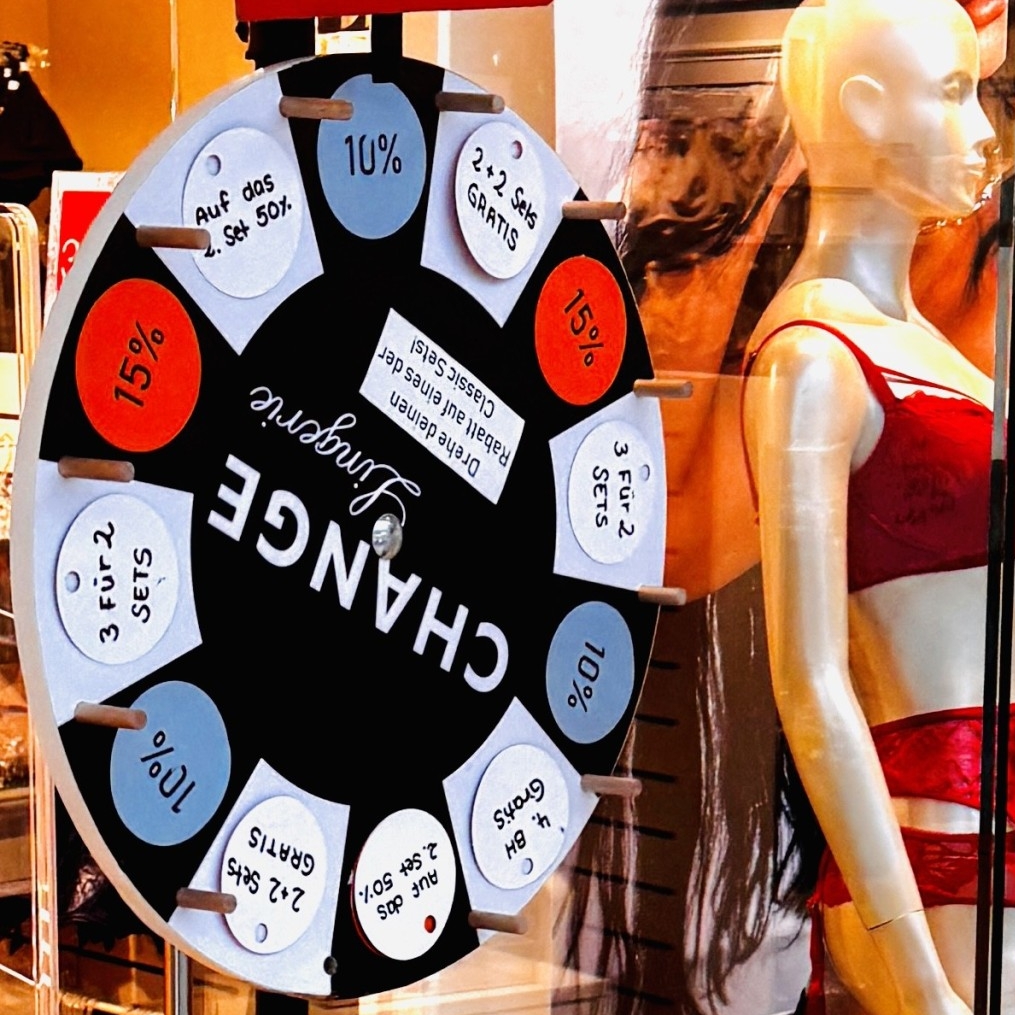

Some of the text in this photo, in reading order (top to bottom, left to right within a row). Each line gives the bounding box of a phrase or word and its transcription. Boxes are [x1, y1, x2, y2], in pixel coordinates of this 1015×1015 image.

[344, 133, 402, 176] 10%
[195, 173, 275, 226] Auf das
[467, 183, 519, 251] GRATIS
[511, 186, 538, 230] Sets
[223, 219, 250, 247] Set
[563, 288, 605, 367] 15%
[113, 320, 166, 408] 15%
[408, 335, 496, 419] Classic Sets!
[377, 346, 512, 467] Rabatt auf eines der
[249, 386, 422, 527] Lingerie
[389, 390, 481, 478] Drehe deinen
[613, 440, 629, 458] 3
[592, 465, 610, 529] SETS
[93, 521, 115, 550] 2
[618, 520, 635, 539] 2
[131, 547, 153, 624] SETS
[206, 453, 509, 693] CHANGE
[100, 623, 120, 645] 3
[567, 641, 605, 713] 10%
[140, 730, 196, 814] 10%
[493, 778, 545, 830] Gratis
[248, 826, 315, 877] GRATIS
[399, 852, 423, 877] Set
[505, 829, 527, 860] BH
[227, 856, 261, 895] Sets
[376, 894, 404, 921] das
